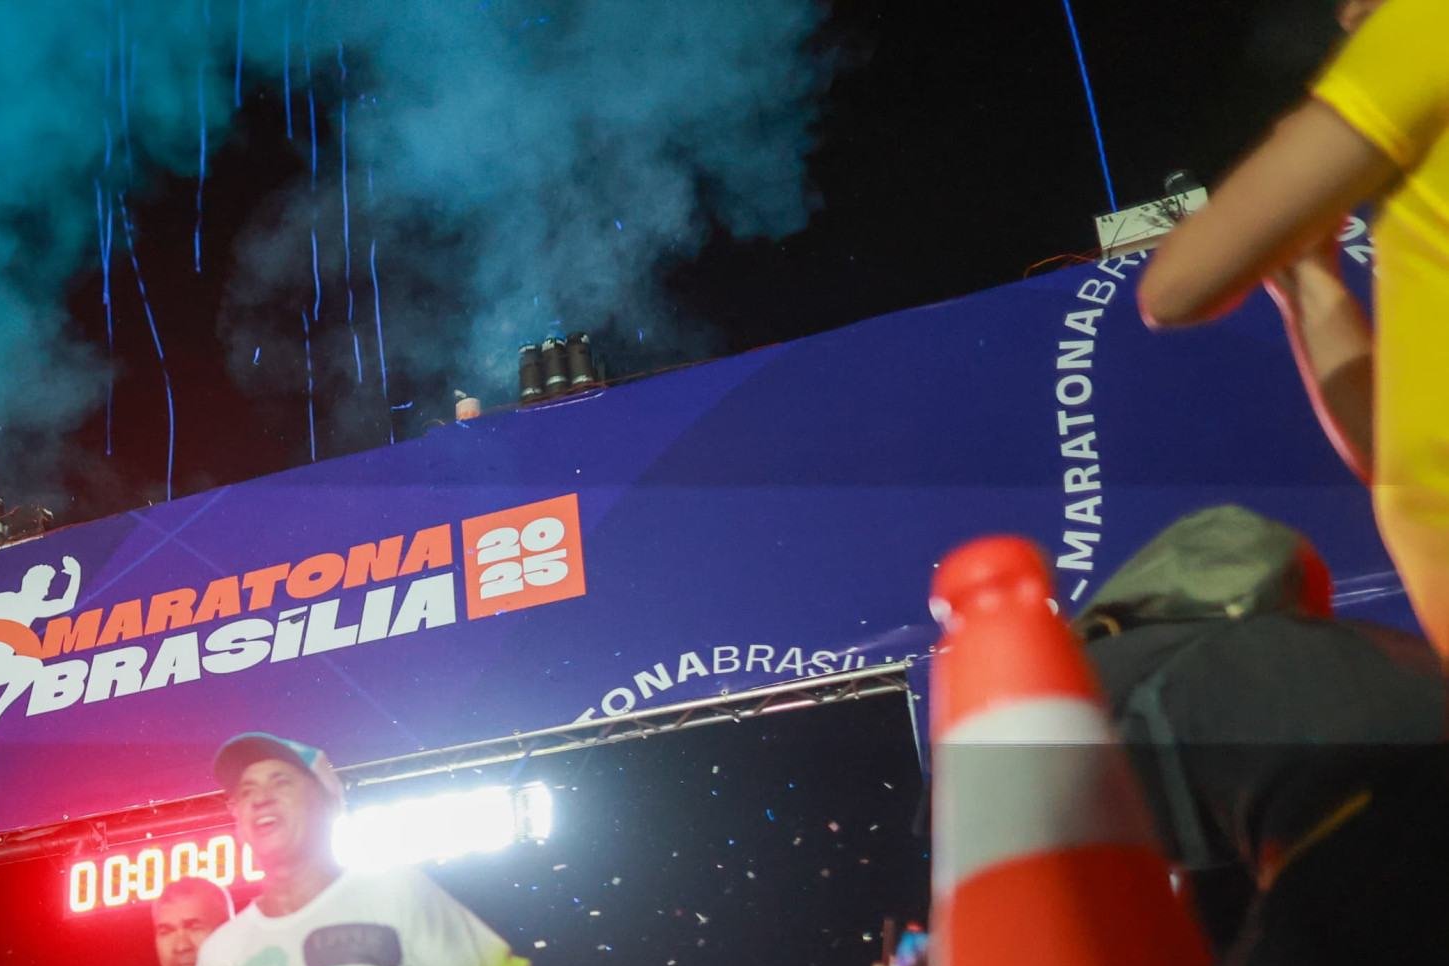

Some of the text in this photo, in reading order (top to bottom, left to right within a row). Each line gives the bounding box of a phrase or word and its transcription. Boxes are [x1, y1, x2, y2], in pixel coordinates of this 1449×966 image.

[476, 517, 565, 566] 20
[479, 549, 569, 600] 25
[42, 523, 453, 660] MARATONA
[26, 572, 456, 717] BRASÍLIA
